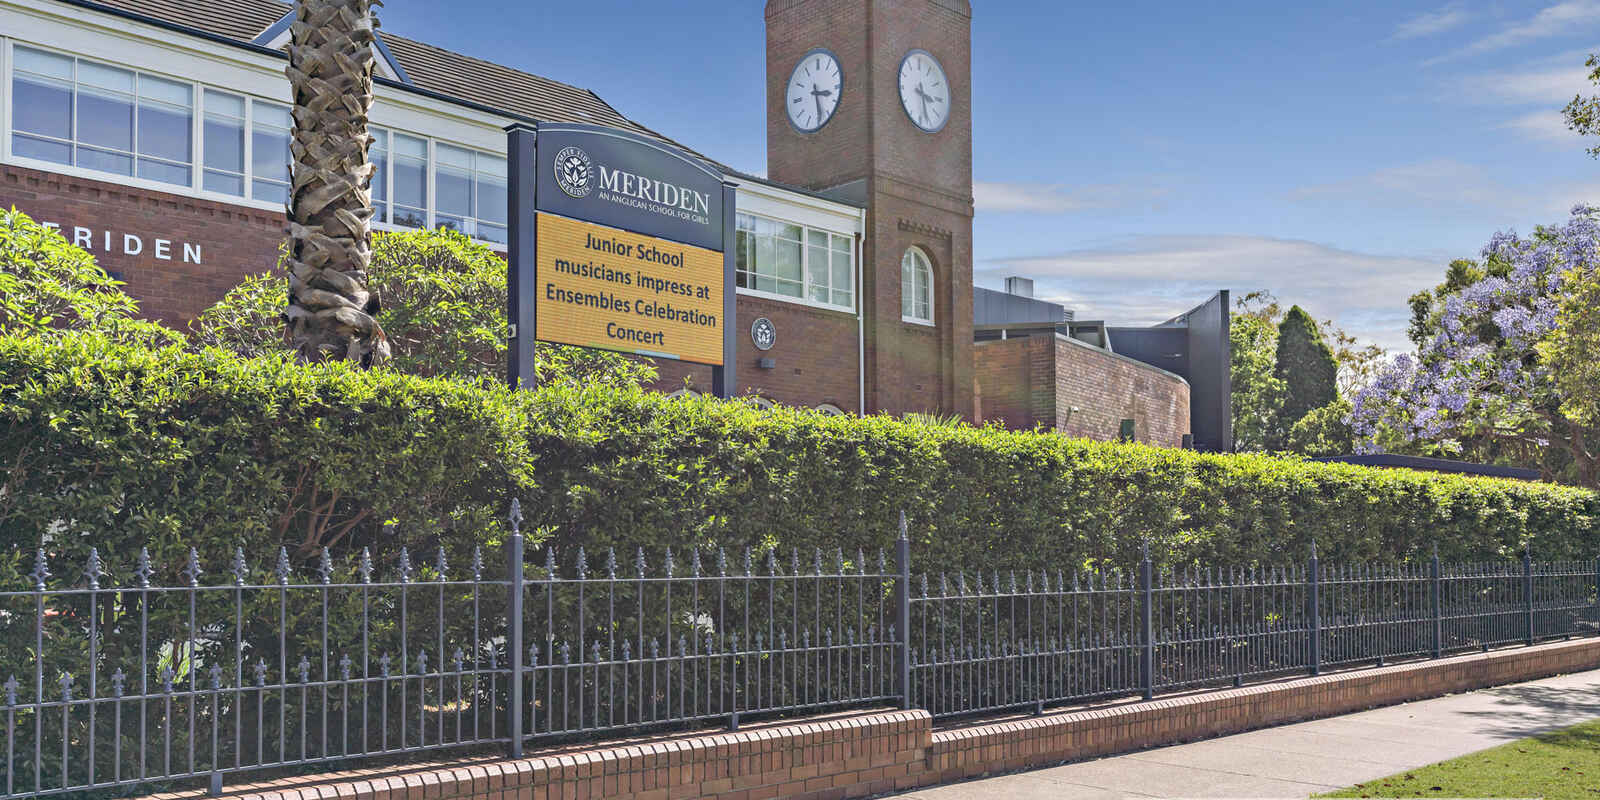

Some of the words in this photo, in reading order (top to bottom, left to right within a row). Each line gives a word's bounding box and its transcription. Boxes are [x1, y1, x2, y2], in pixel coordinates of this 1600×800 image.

[598, 165, 711, 215] MERIDEN
[598, 191, 610, 201] AN
[611, 194, 647, 211] ANGLICAN
[648, 203, 675, 217] SCHOOL
[677, 210, 690, 220] FOR
[691, 214, 710, 225] GIRLS
[42, 222, 201, 264] RIDEN
[584, 232, 633, 257] Junior
[636, 243, 684, 268] School
[555, 258, 632, 285] musicians
[636, 270, 693, 297] impress
[696, 285, 710, 300] at
[546, 283, 631, 313] Ensembles
[634, 299, 717, 328] Celebration
[606, 322, 665, 346] Concert
